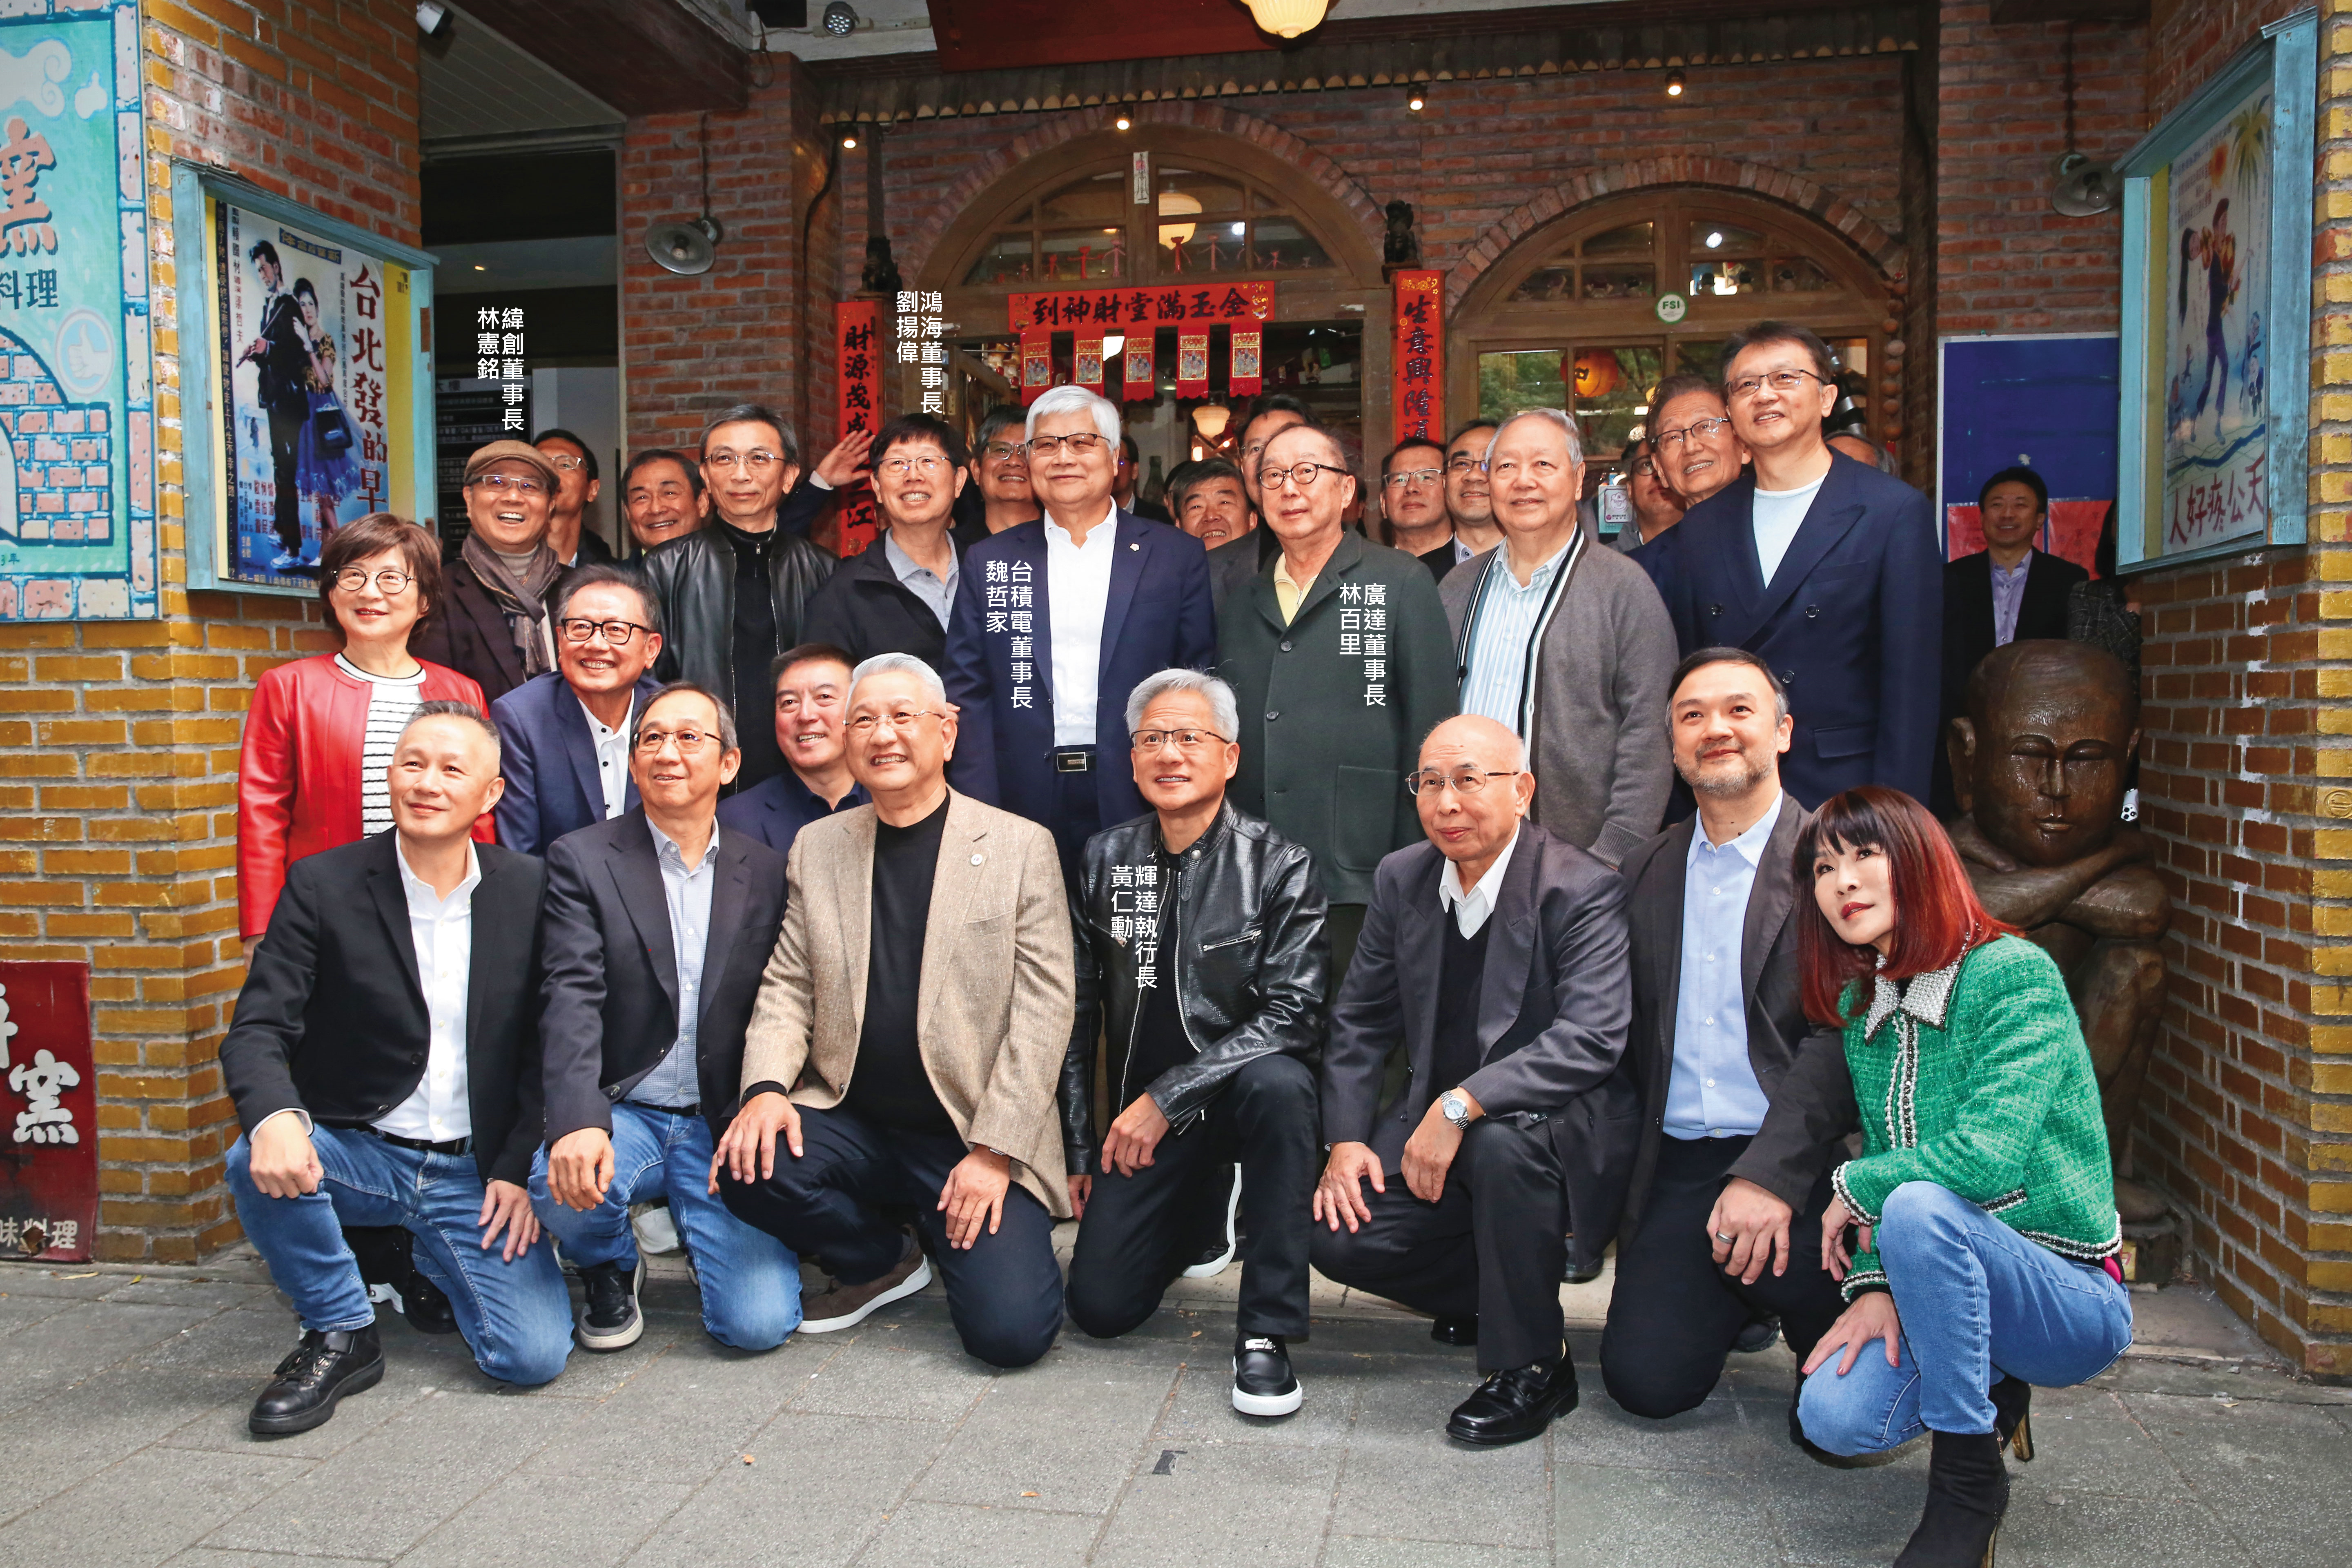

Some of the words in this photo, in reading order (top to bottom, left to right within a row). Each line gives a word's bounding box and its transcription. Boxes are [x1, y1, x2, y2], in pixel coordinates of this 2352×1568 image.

[350, 263, 388, 513] 台北發的早
[1662, 301, 1680, 310] FSI
[843, 325, 873, 528] 財源茂盛三江
